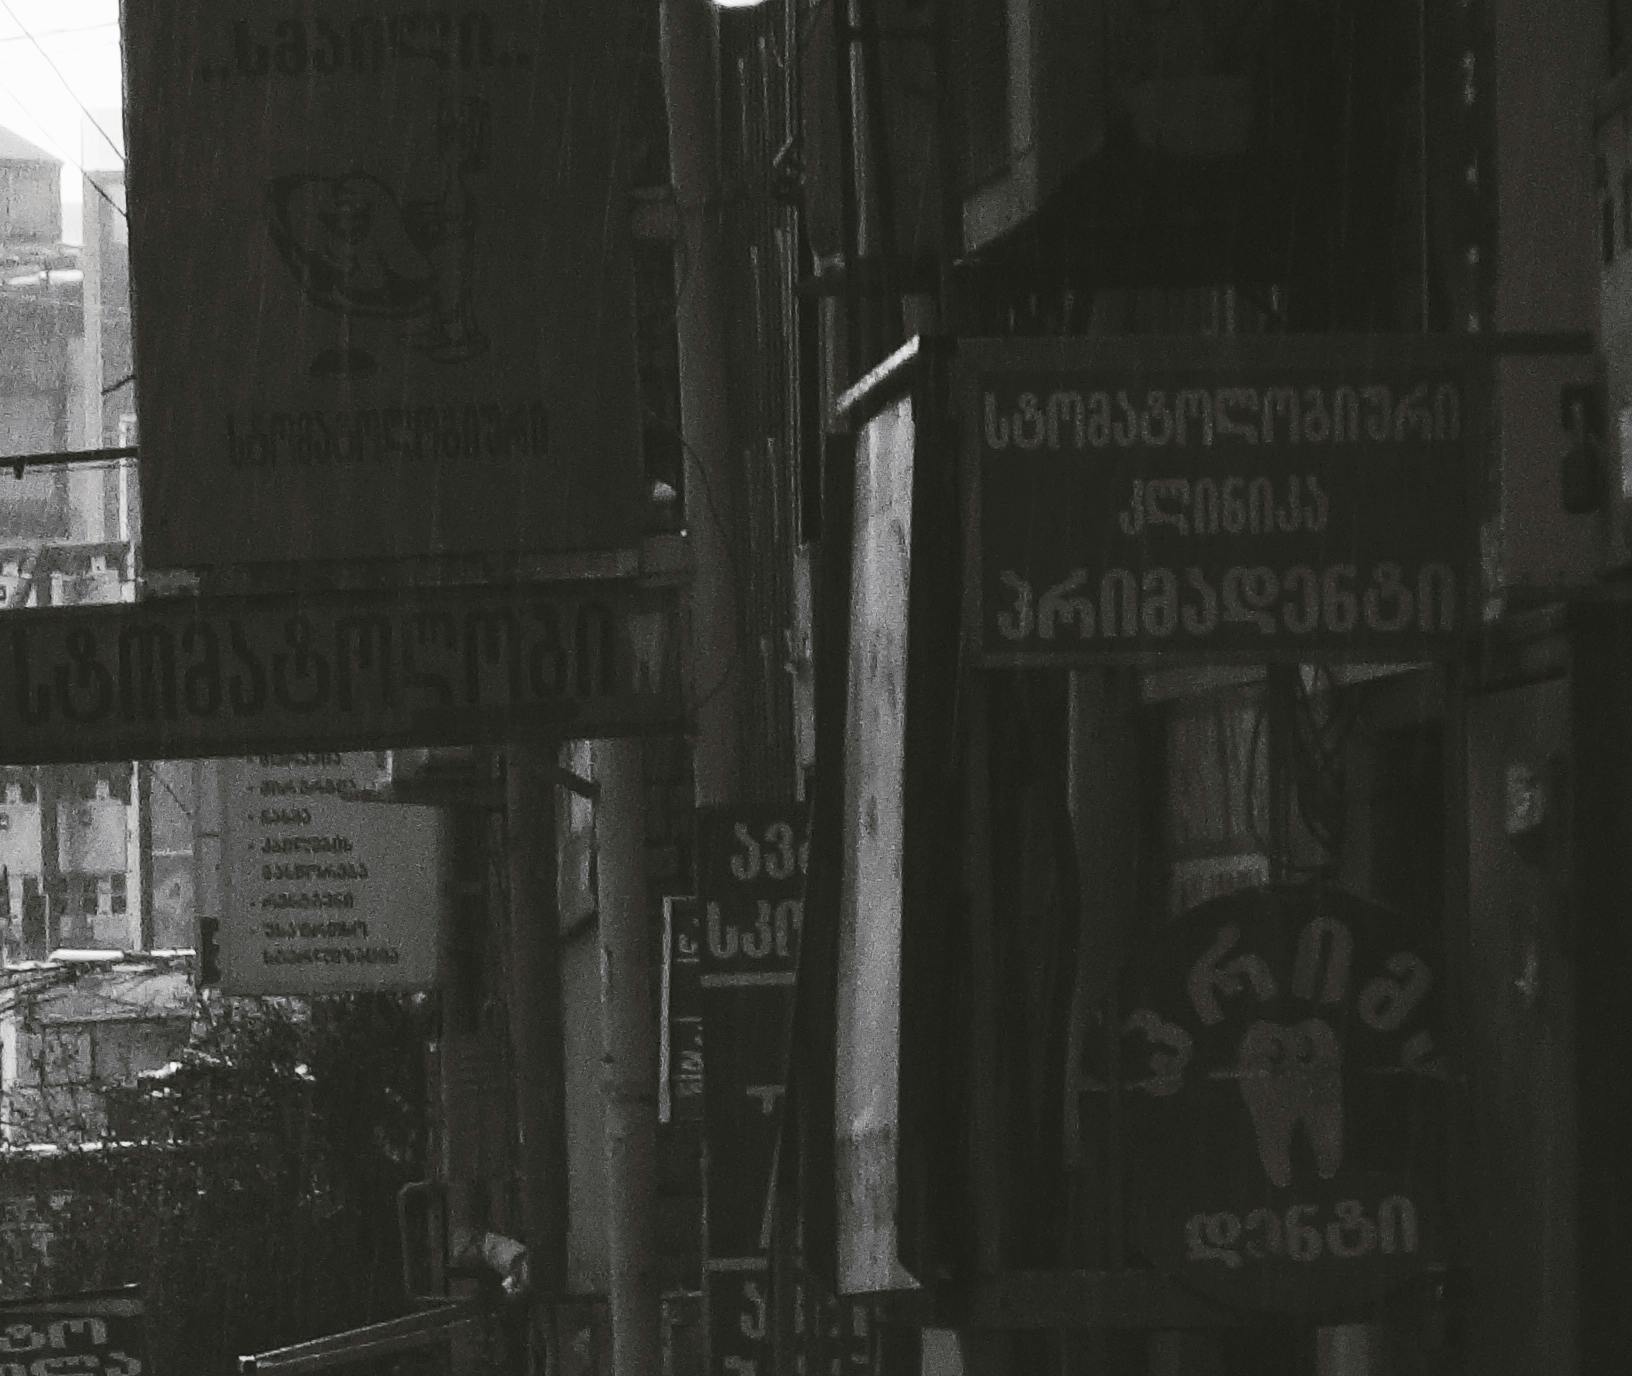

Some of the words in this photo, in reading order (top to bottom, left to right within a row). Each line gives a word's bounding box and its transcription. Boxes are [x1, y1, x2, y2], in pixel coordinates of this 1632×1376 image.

[982, 381, 1462, 452] სტომატოლოგიური
[1117, 473, 1331, 537] კლინიკა
[995, 559, 1457, 641] პრიმადენტი
[12, 600, 616, 727] სტომატოლოგი
[1184, 1193, 1420, 1269] დენტი
